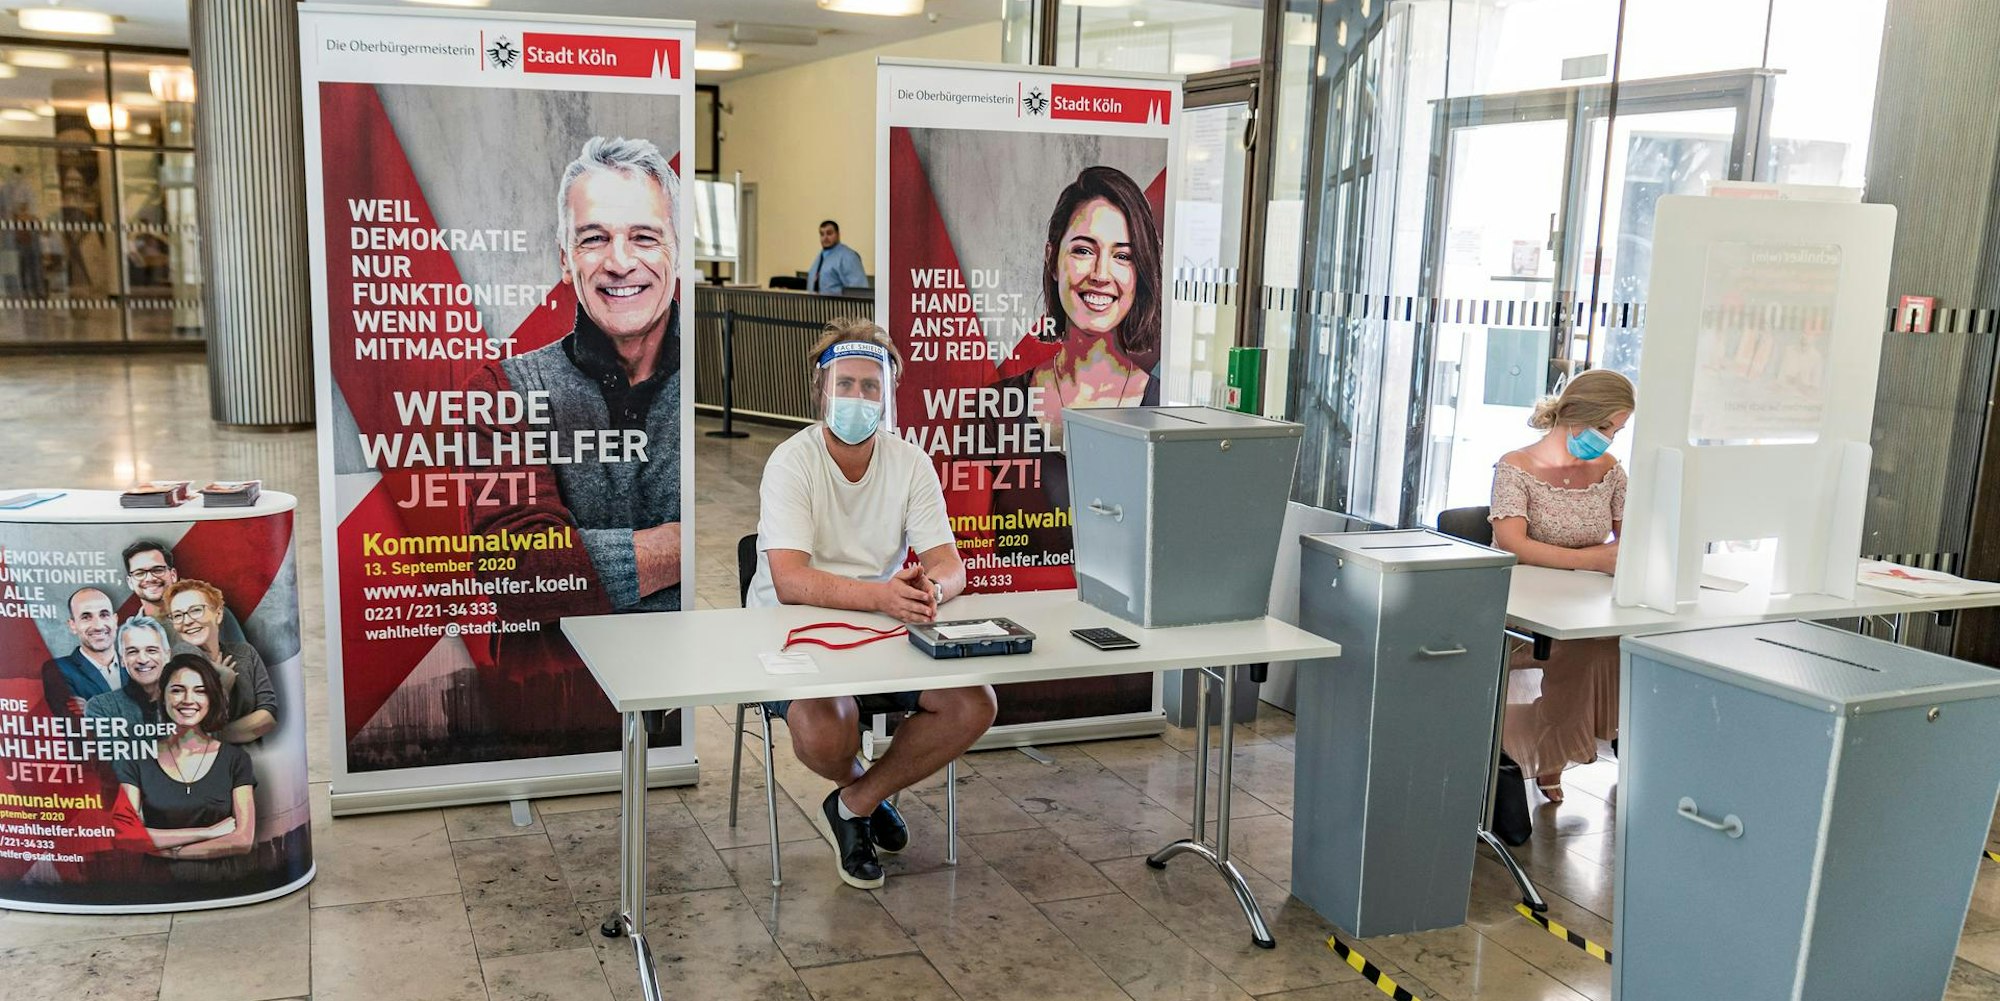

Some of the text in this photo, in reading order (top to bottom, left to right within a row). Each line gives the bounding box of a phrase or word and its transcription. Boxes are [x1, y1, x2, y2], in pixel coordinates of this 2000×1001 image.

[326, 39, 475, 57] Die Oberbürgermeisterin
[528, 46, 617, 66] Stadt Köln
[898, 89, 1014, 104] Die Oberbürgermeisterin
[1054, 96, 1122, 113] Stadt Köln
[348, 199, 419, 223] WEIL
[351, 227, 527, 252] DEMOKRATIE
[352, 255, 411, 278] NUR
[910, 268, 999, 289] WEIL DU
[353, 283, 557, 309] FUNKTIONIERT,
[911, 293, 1026, 316] HANDELST,
[353, 310, 482, 333] WENN DU
[910, 317, 1056, 337] ANSTATT NUR
[355, 338, 523, 360] MITMACHST.
[836, 343, 883, 354] FACE SHIELD
[910, 341, 1021, 362] ZU REDEN.
[394, 390, 550, 426] WERDE
[923, 387, 1045, 420] WERDE
[359, 429, 649, 469] WAHLHELFER
[895, 423, 1066, 457] WAHLHEL
[397, 471, 537, 509] JETZT!
[363, 526, 573, 556] Kommunalwahl
[998, 534, 1029, 548] 2020
[0, 550, 106, 566] EMOKRATIE
[364, 557, 516, 576] 13. September 2020
[4, 585, 45, 601] ALLE
[363, 574, 587, 601] www.wahlhelfer.koeln
[364, 606, 401, 621] 0221
[365, 618, 540, 641] wahlhelfer@stadt.koeln
[0, 714, 178, 738] HLHELFER ODER
[6, 761, 84, 784] JETZT!
[40, 812, 65, 821] 2020
